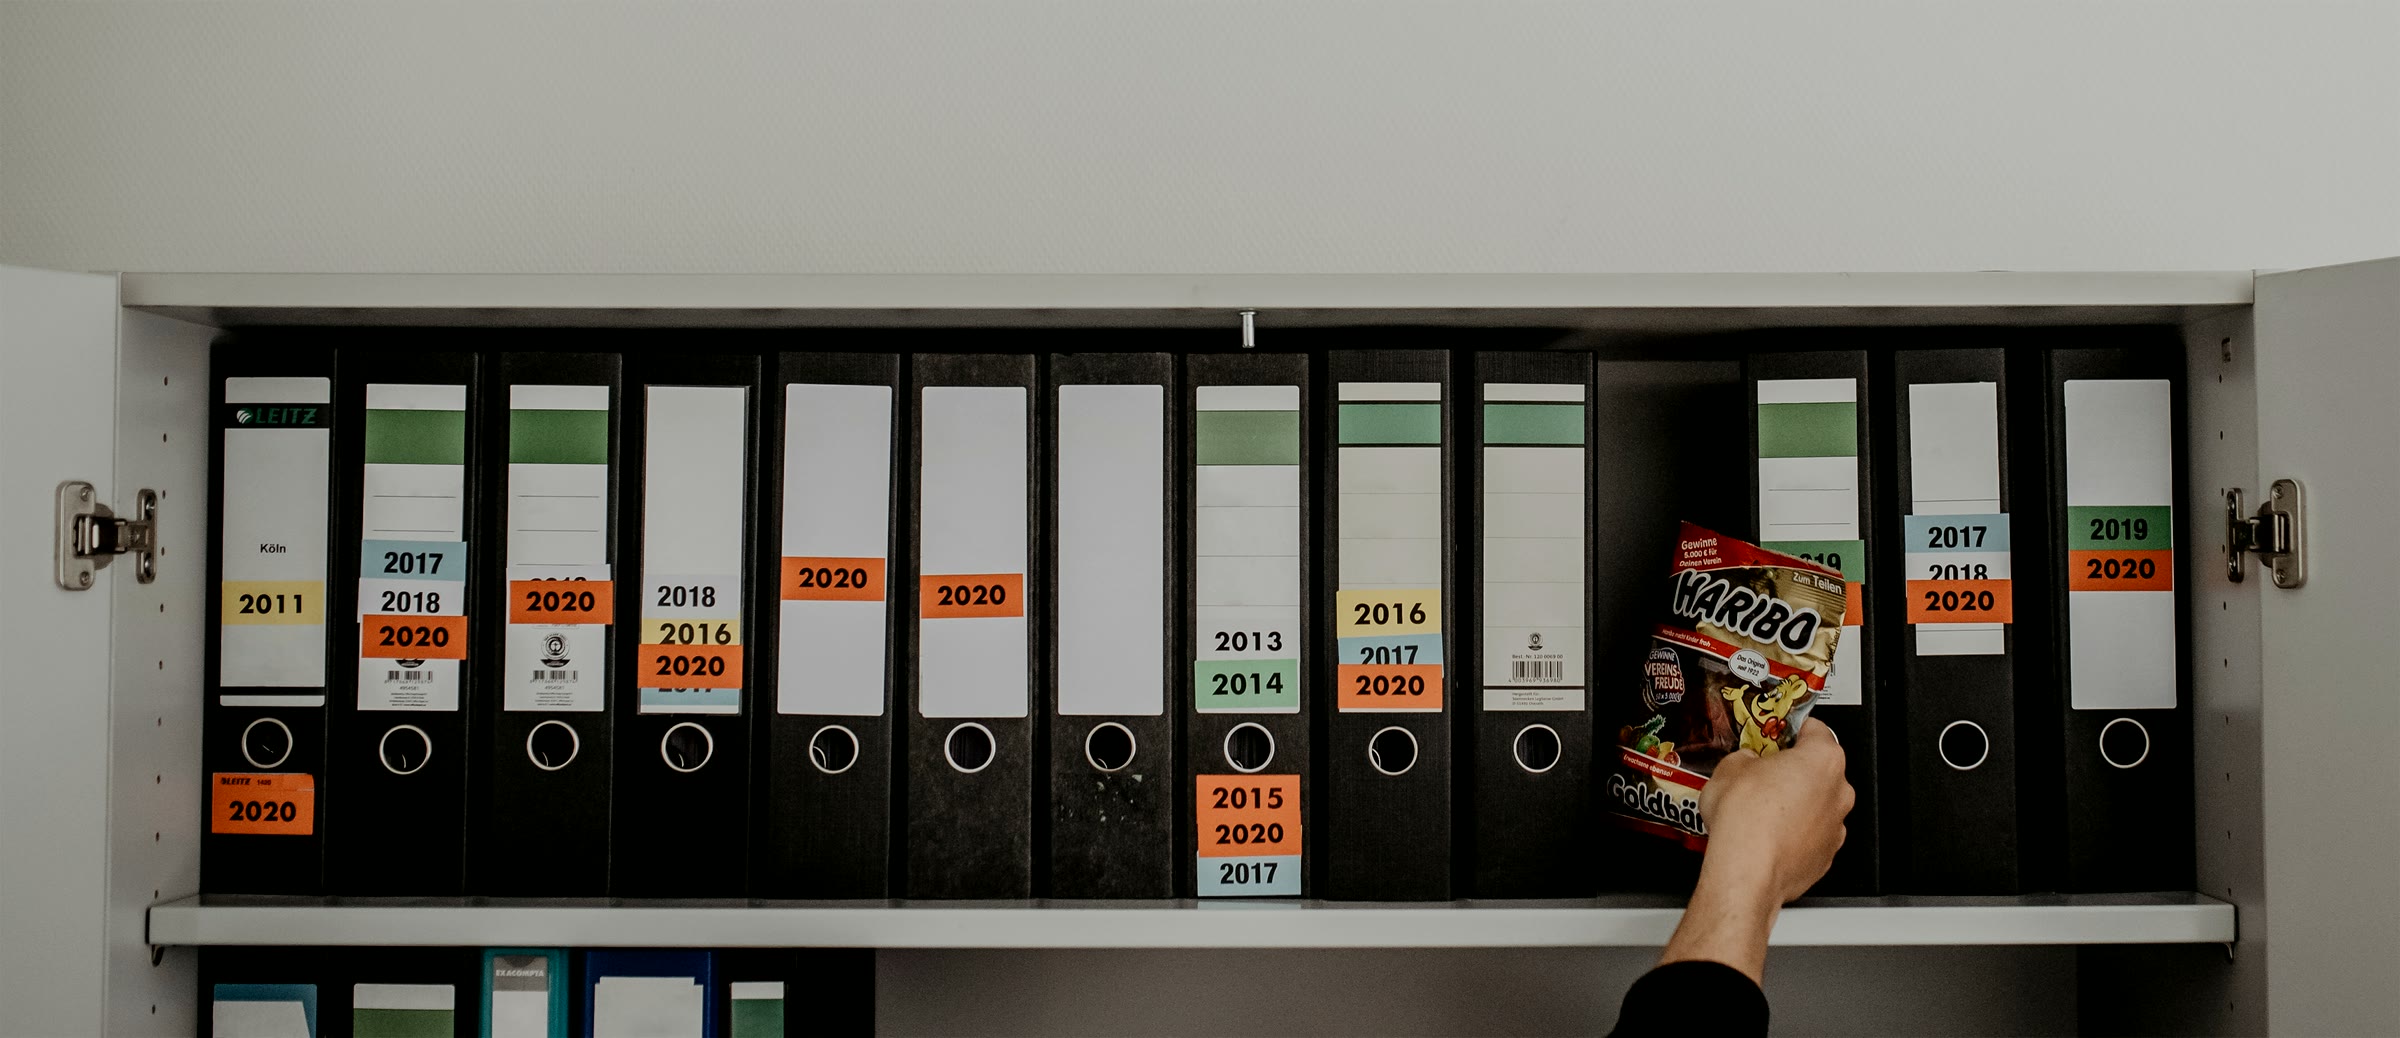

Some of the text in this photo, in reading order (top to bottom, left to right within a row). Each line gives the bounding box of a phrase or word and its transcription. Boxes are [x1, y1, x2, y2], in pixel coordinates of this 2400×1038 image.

[256, 407, 318, 424] LEITZ
[1928, 526, 1987, 548] 2017
[2090, 518, 2148, 541] 2019
[260, 543, 286, 554] Köln
[1681, 538, 1718, 550] Gewinne
[1684, 550, 1703, 559] 5.000
[1708, 548, 1718, 556] für
[384, 551, 443, 574] 2017
[1679, 557, 1722, 567] Deinen Verein
[2087, 558, 2156, 580] 2020
[799, 567, 868, 589] 2020
[1793, 571, 1842, 595] Zum Teilen
[239, 593, 302, 614] 2011
[381, 591, 440, 613] 2018
[526, 591, 595, 612] 2020
[657, 585, 716, 608] 2018
[937, 585, 1006, 606] 2020
[1924, 590, 1995, 612] 2020
[1354, 602, 1426, 625] 2016
[1673, 568, 1821, 654] HARIBO
[380, 626, 449, 647] 2020
[659, 623, 731, 645] 2016
[1215, 631, 1283, 652] 2013
[1686, 634, 1699, 643] Kinder
[1698, 638, 1711, 648] froh
[656, 655, 725, 676] 2020
[1360, 645, 1419, 665] 2017
[1649, 650, 1675, 661] GEWINNE
[1737, 654, 1766, 669] Das Original
[1644, 662, 1681, 677] VEREINS-
[1747, 666, 1760, 677] 1922
[1212, 672, 1284, 696] 2014
[1355, 675, 1425, 696] 2020
[1654, 676, 1684, 691] FREUDE
[227, 777, 251, 785] LEITZ
[1649, 764, 1673, 778] ebenso!
[1212, 787, 1284, 809] 2015
[229, 801, 297, 822] 2020
[1215, 823, 1284, 845] 2020
[1220, 862, 1278, 885] 2017
[495, 969, 544, 977] EXACOMPTA
